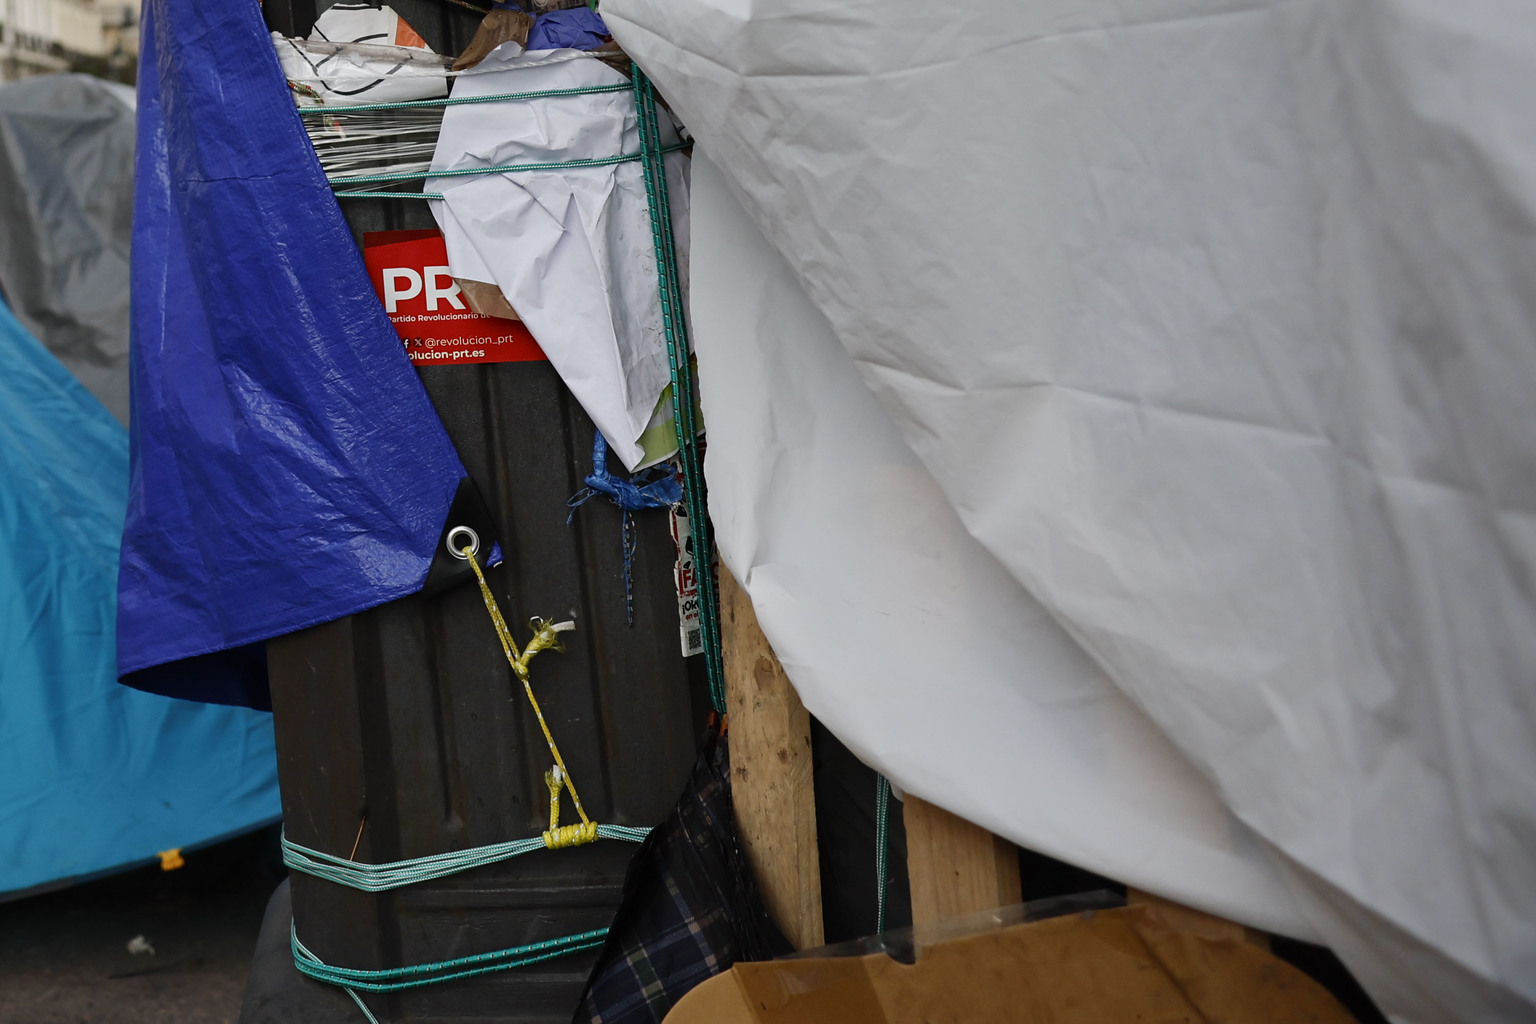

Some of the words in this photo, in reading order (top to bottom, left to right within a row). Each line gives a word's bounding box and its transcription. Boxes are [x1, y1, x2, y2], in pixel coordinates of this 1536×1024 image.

[382, 266, 467, 313] PR
[418, 312, 479, 322] Revolucionario
[425, 334, 514, 349] @revolucion_prt
[408, 349, 486, 360] olucion-prt.es
